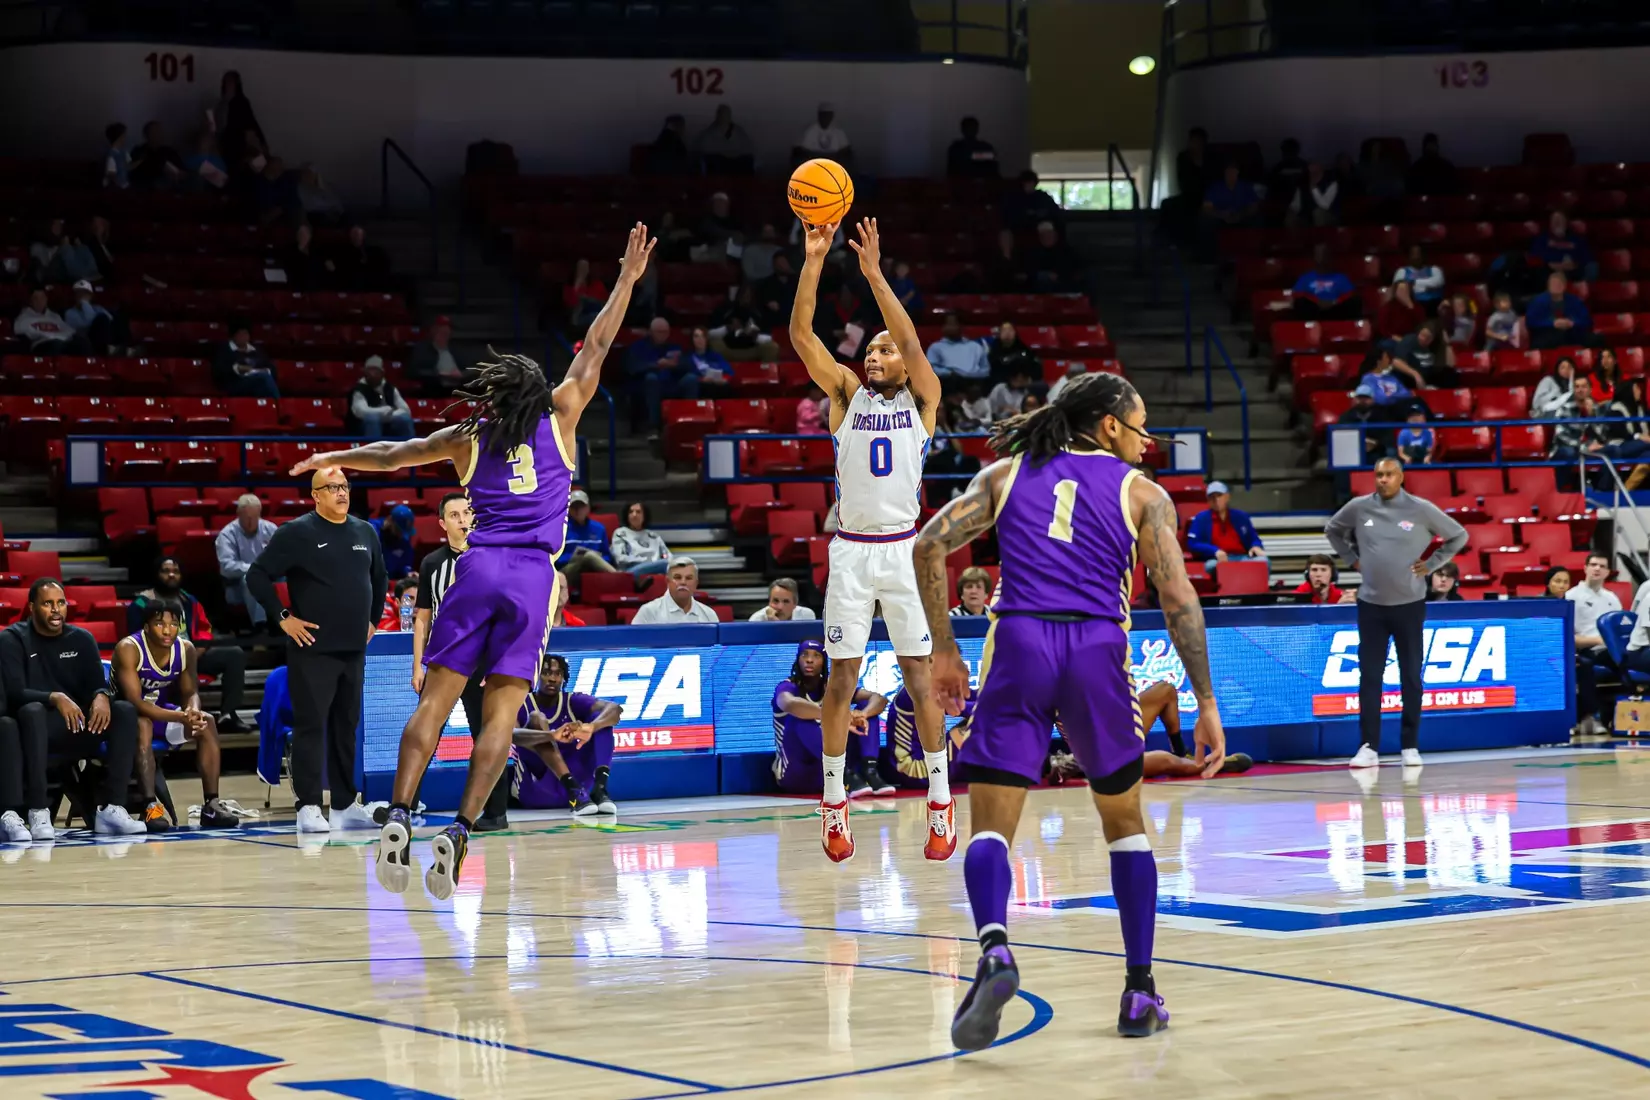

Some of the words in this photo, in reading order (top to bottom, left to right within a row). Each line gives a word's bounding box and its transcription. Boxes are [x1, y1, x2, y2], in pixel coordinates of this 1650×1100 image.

[144, 53, 193, 82] 101
[670, 67, 724, 95] 102
[1433, 60, 1489, 89] 103
[852, 413, 891, 431] LOUSIANA
[891, 409, 913, 429] TECH
[506, 444, 538, 495] 3
[870, 437, 893, 477] 0
[1048, 479, 1079, 543] 1
[1435, 692, 1459, 706] ON
[1462, 690, 1486, 704] US
[641, 730, 673, 746] US
